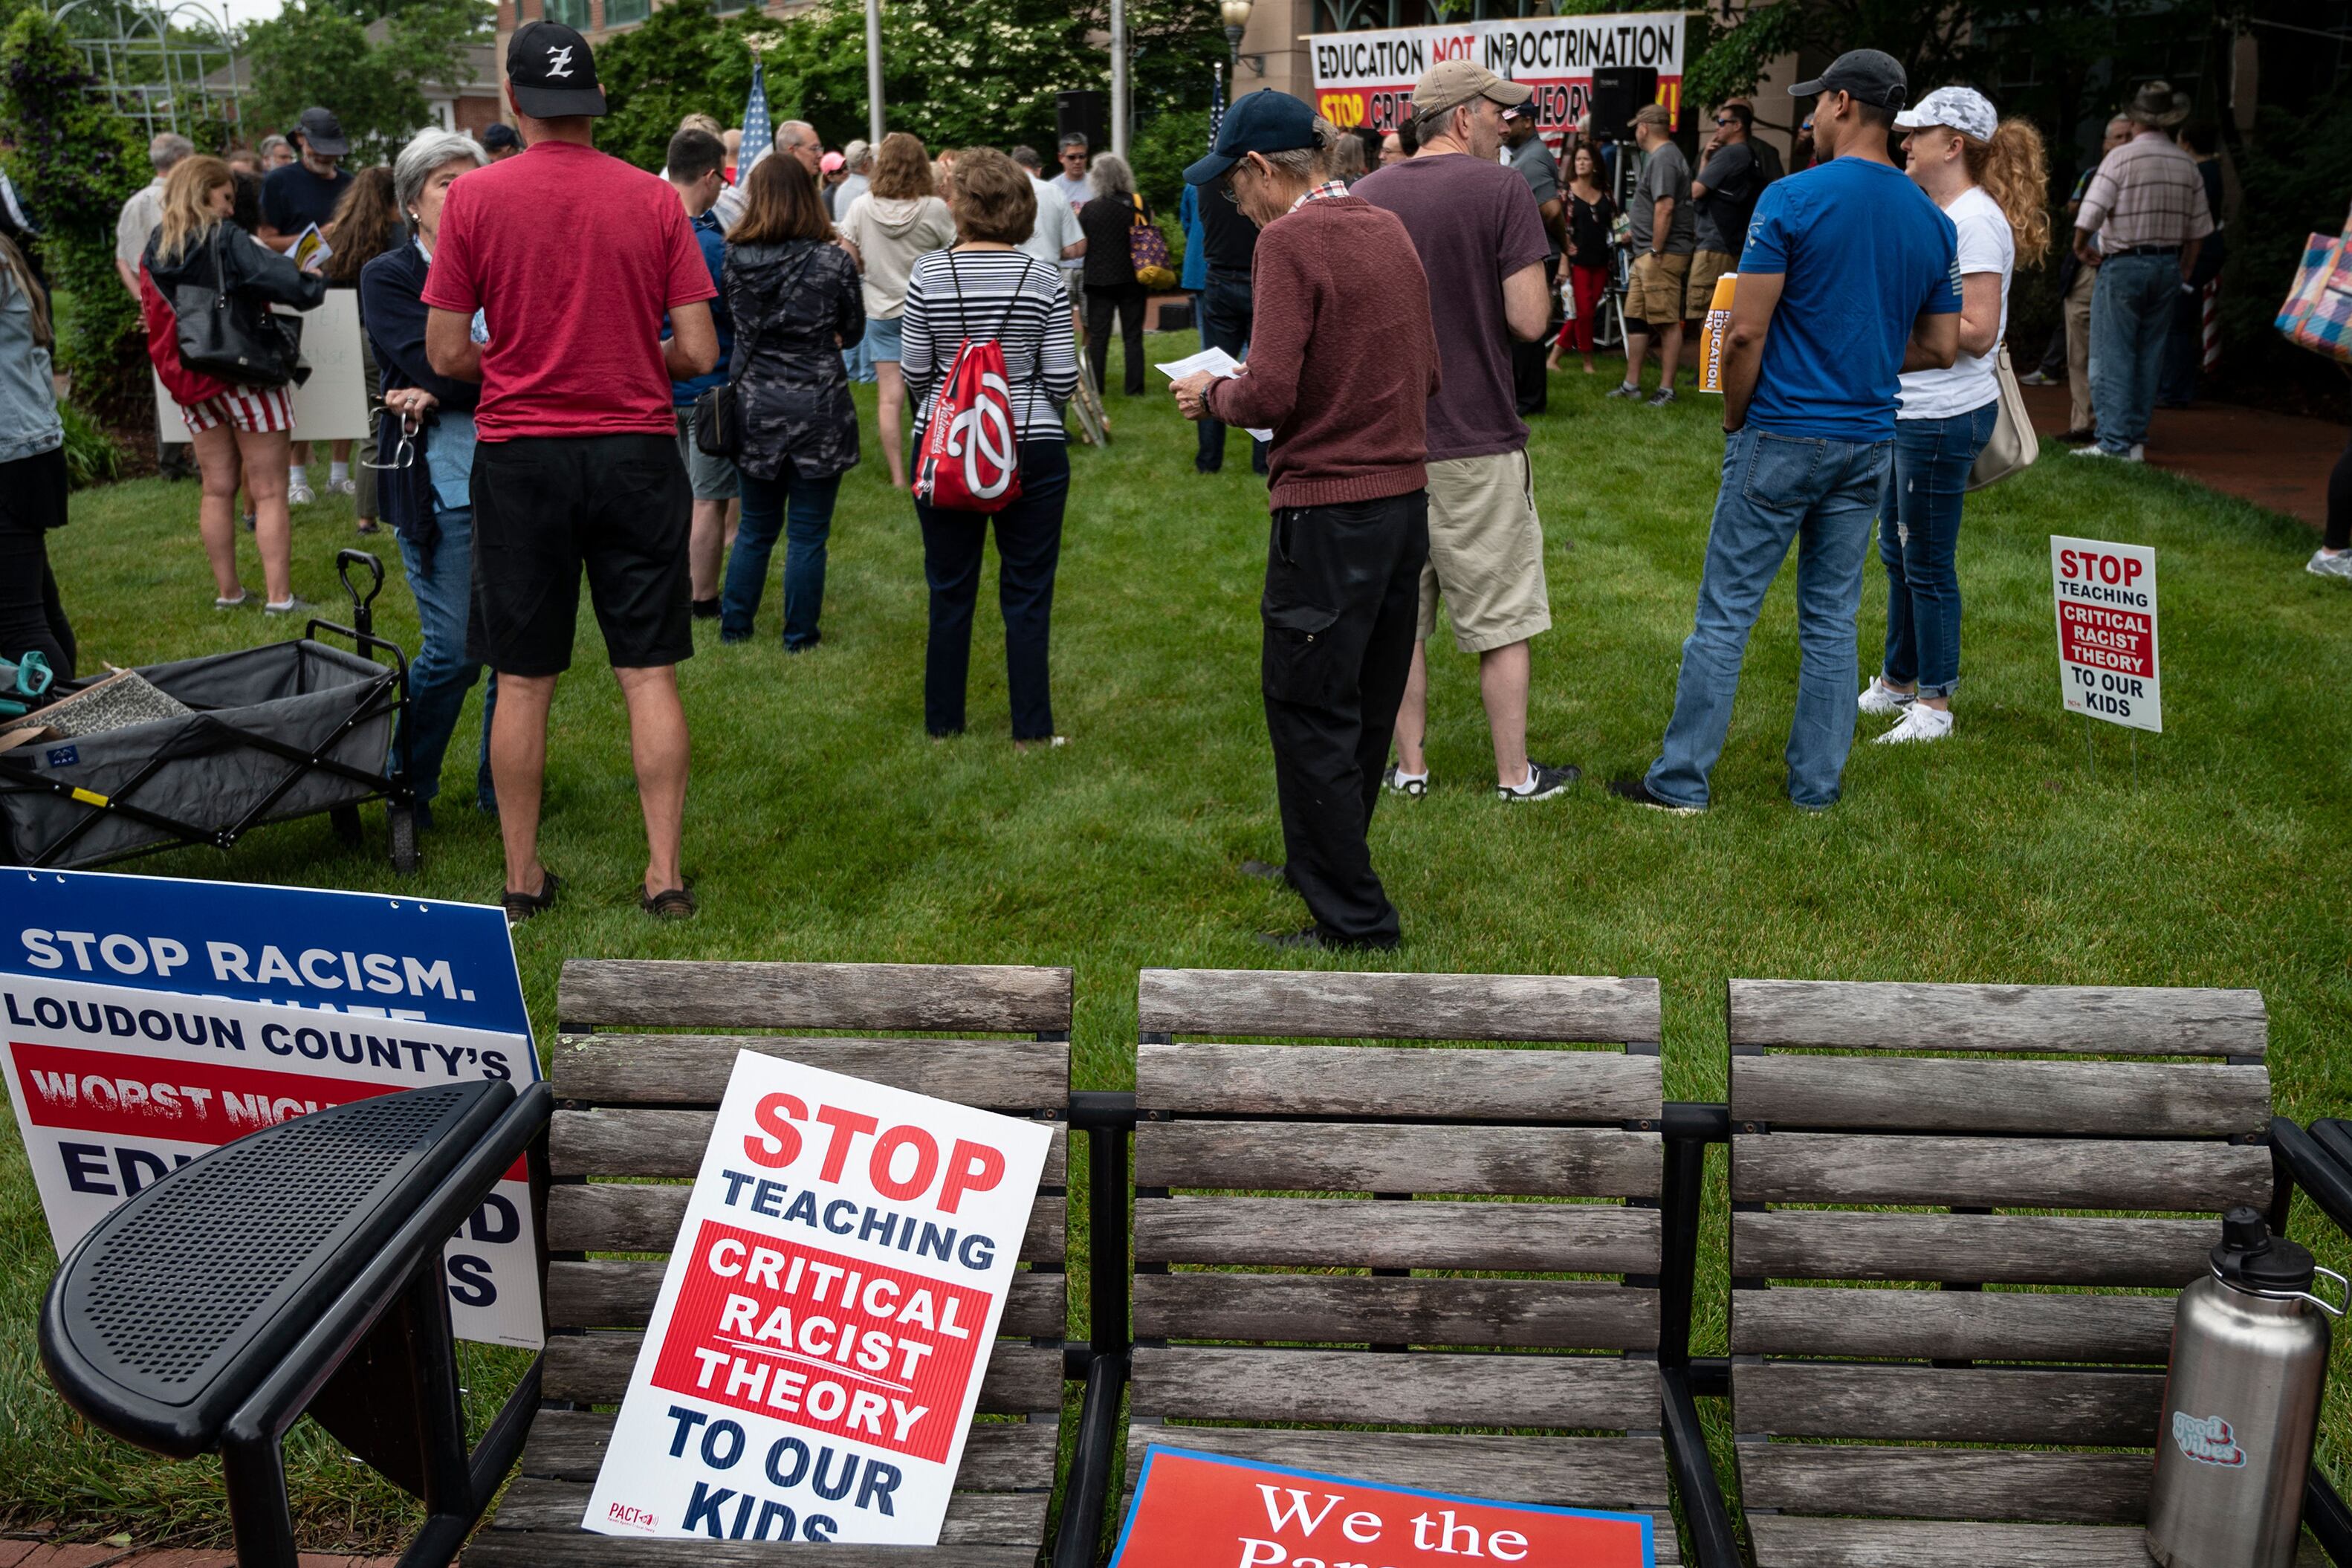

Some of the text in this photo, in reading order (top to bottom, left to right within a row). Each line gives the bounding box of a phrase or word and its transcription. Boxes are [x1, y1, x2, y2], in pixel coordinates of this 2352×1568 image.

[1318, 25, 1674, 79] EDUCATION NOT INDOCTRINATION
[1321, 94, 1364, 128] STOP
[1704, 310, 1714, 331] MY
[1707, 310, 1724, 388] EDUCATION
[931, 398, 956, 455] Nationals
[2060, 549, 2142, 587] STOP
[2059, 581, 2148, 607] TEACHING
[2064, 605, 2148, 634] CRITICAL
[2071, 645, 2143, 673] THEORY
[2073, 625, 2139, 651] RACIST
[2071, 666, 2144, 699] TO OUR
[2085, 690, 2131, 717] KIDS
[21, 927, 476, 1002] STOP RACISM.
[4, 993, 247, 1050] LOUDOUN
[261, 1023, 511, 1081] COUNTY'S
[30, 1069, 213, 1120] WORST
[744, 1092, 1005, 1214] STOP
[722, 1169, 996, 1271] TEACHING
[708, 1238, 970, 1340] CRITICAL
[719, 1293, 933, 1380] RACIST
[694, 1346, 930, 1443] THEORY
[2175, 1416, 2226, 1440] good
[2181, 1434, 2235, 1460] vibes
[668, 1405, 903, 1517] TO OUR
[609, 1503, 641, 1523] PACT
[1255, 1483, 1383, 1543] We
[1410, 1510, 1529, 1561] the
